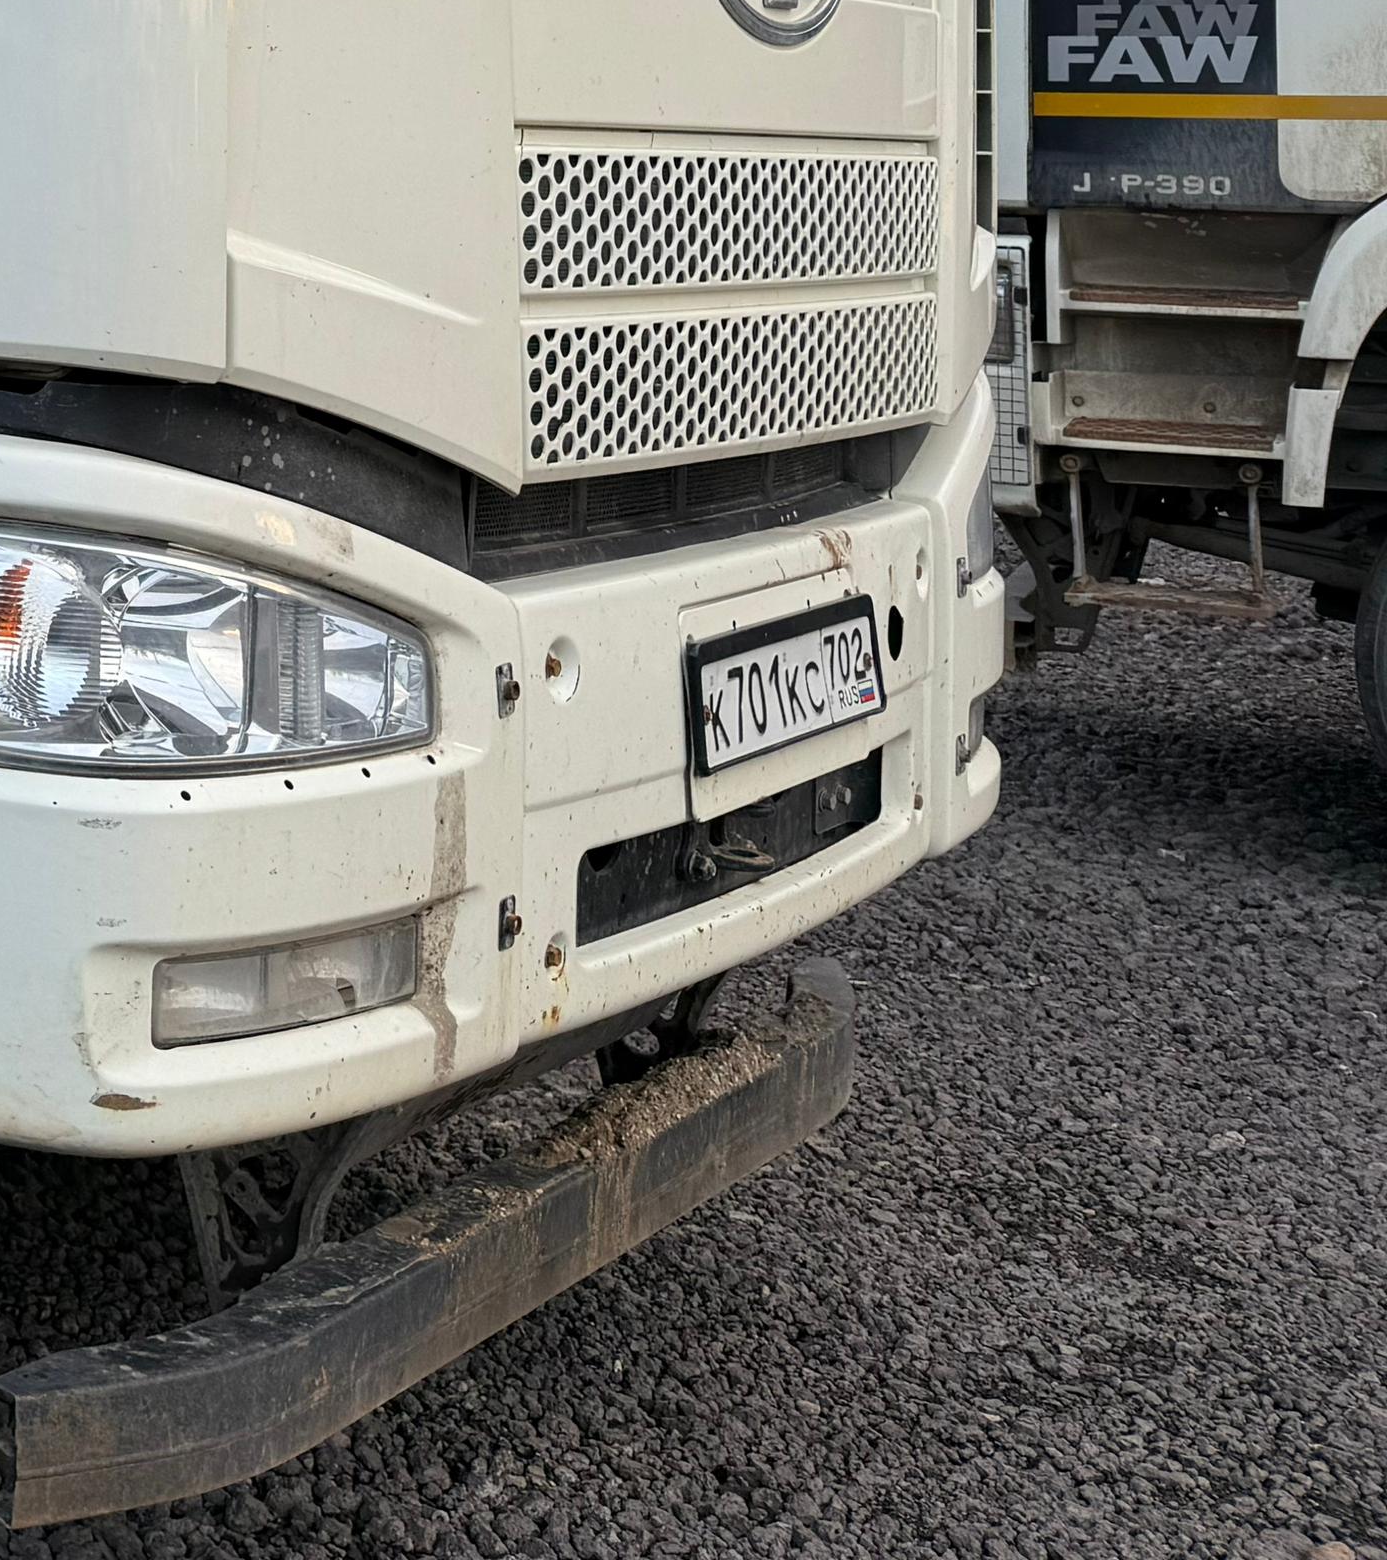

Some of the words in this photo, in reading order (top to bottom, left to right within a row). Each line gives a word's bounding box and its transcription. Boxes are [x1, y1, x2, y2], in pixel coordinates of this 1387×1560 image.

[1077, 4, 1258, 44] FAW
[1047, 35, 1259, 83] FAW
[1073, 172, 1231, 196] JP-390
[823, 628, 867, 690] 702
[838, 685, 860, 709] RUS
